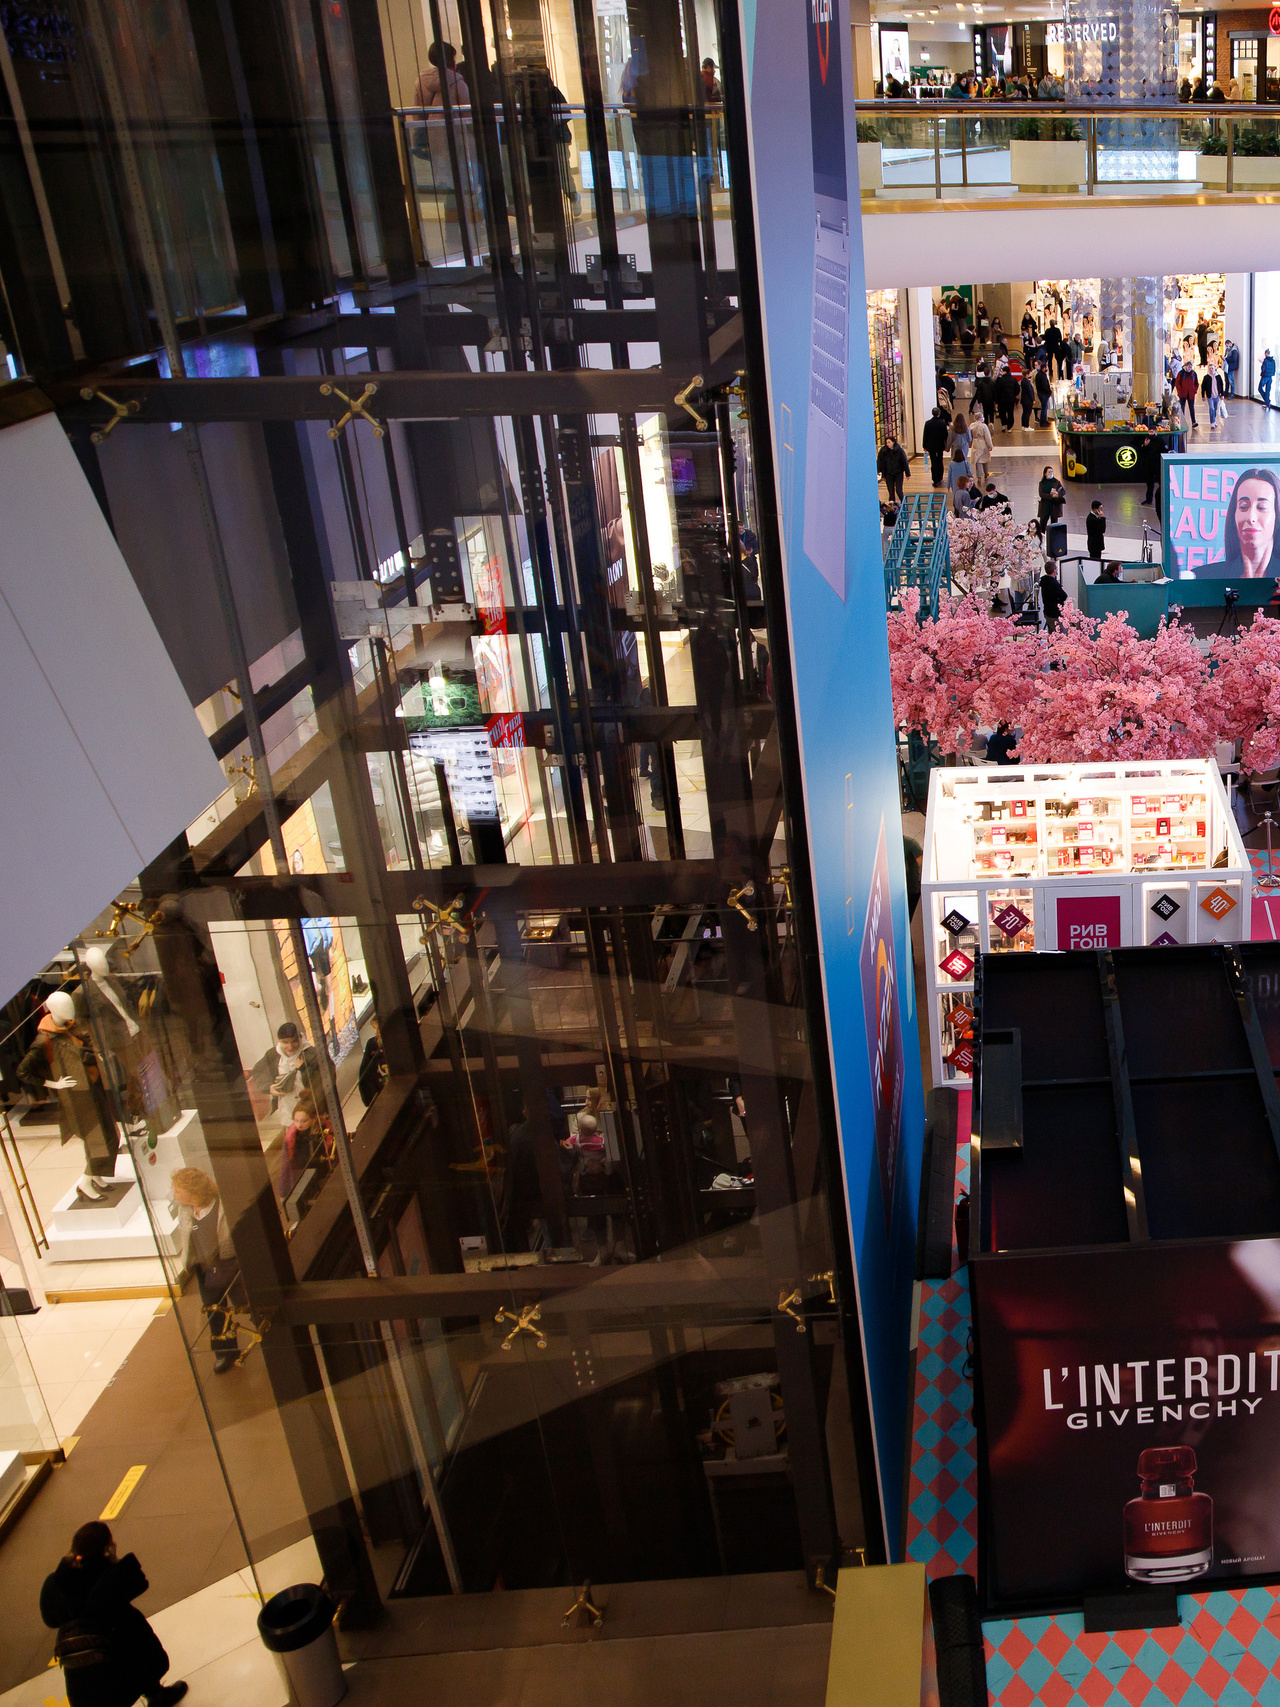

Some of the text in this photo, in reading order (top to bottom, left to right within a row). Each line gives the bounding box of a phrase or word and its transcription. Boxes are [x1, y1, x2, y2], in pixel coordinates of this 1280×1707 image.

[1050, 22, 1117, 43] RESERVED
[1070, 924, 1107, 937] РИВ
[1070, 937, 1108, 950] ГОШ
[1065, 1397, 1263, 1430] GIVENCHY
[1221, 1556, 1242, 1564] НОВЫЙ
